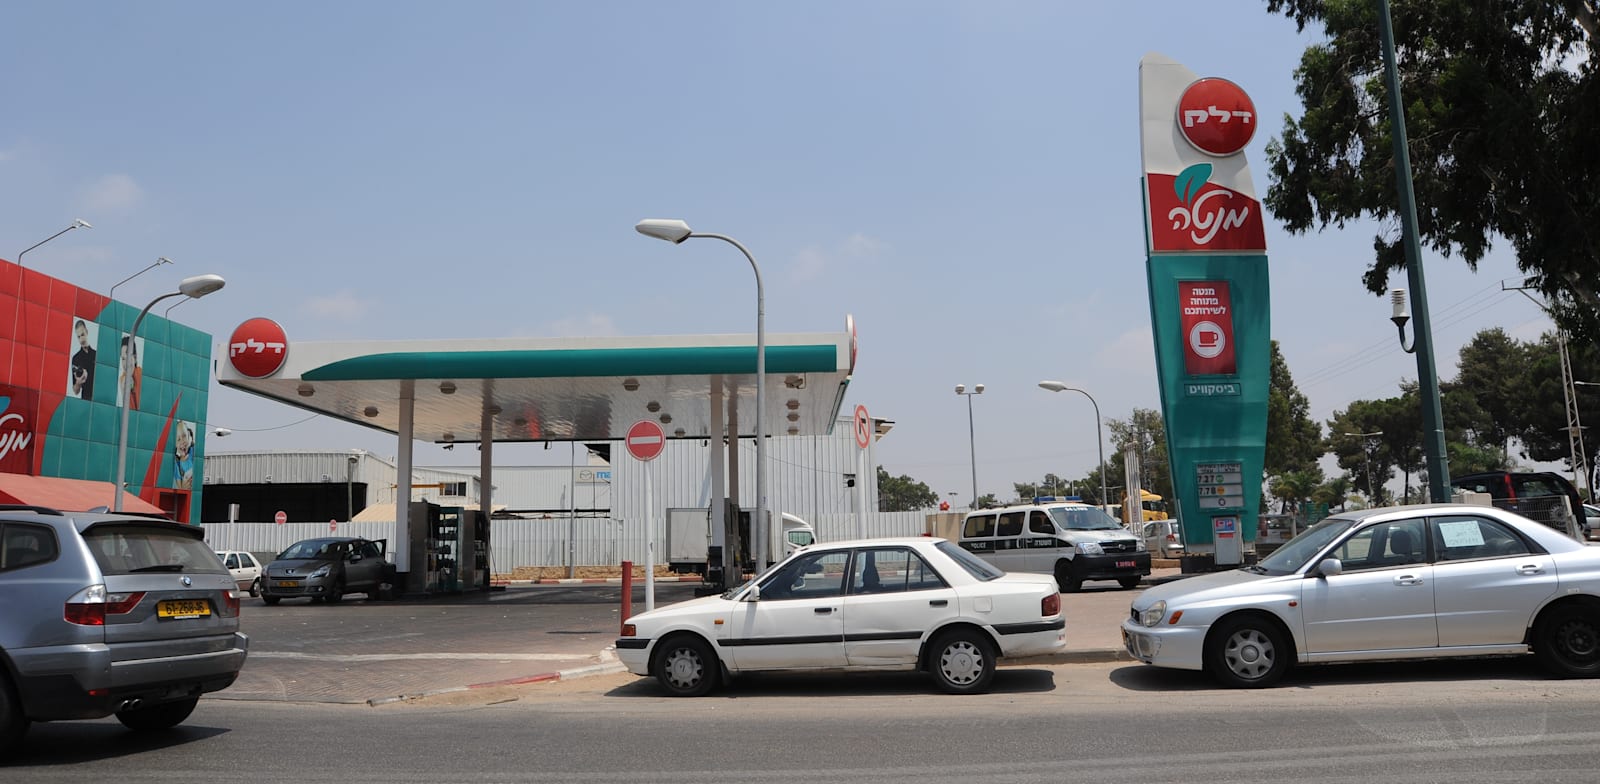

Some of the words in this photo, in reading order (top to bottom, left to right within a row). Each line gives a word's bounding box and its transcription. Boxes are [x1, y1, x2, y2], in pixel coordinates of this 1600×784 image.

[1184, 105, 1253, 128] דלק
[1168, 189, 1249, 245] מנטה
[1192, 287, 1215, 296] מנטה
[1190, 297, 1218, 305] פתוחה
[1184, 305, 1226, 315] לשירותכם
[230, 338, 285, 358] דלק
